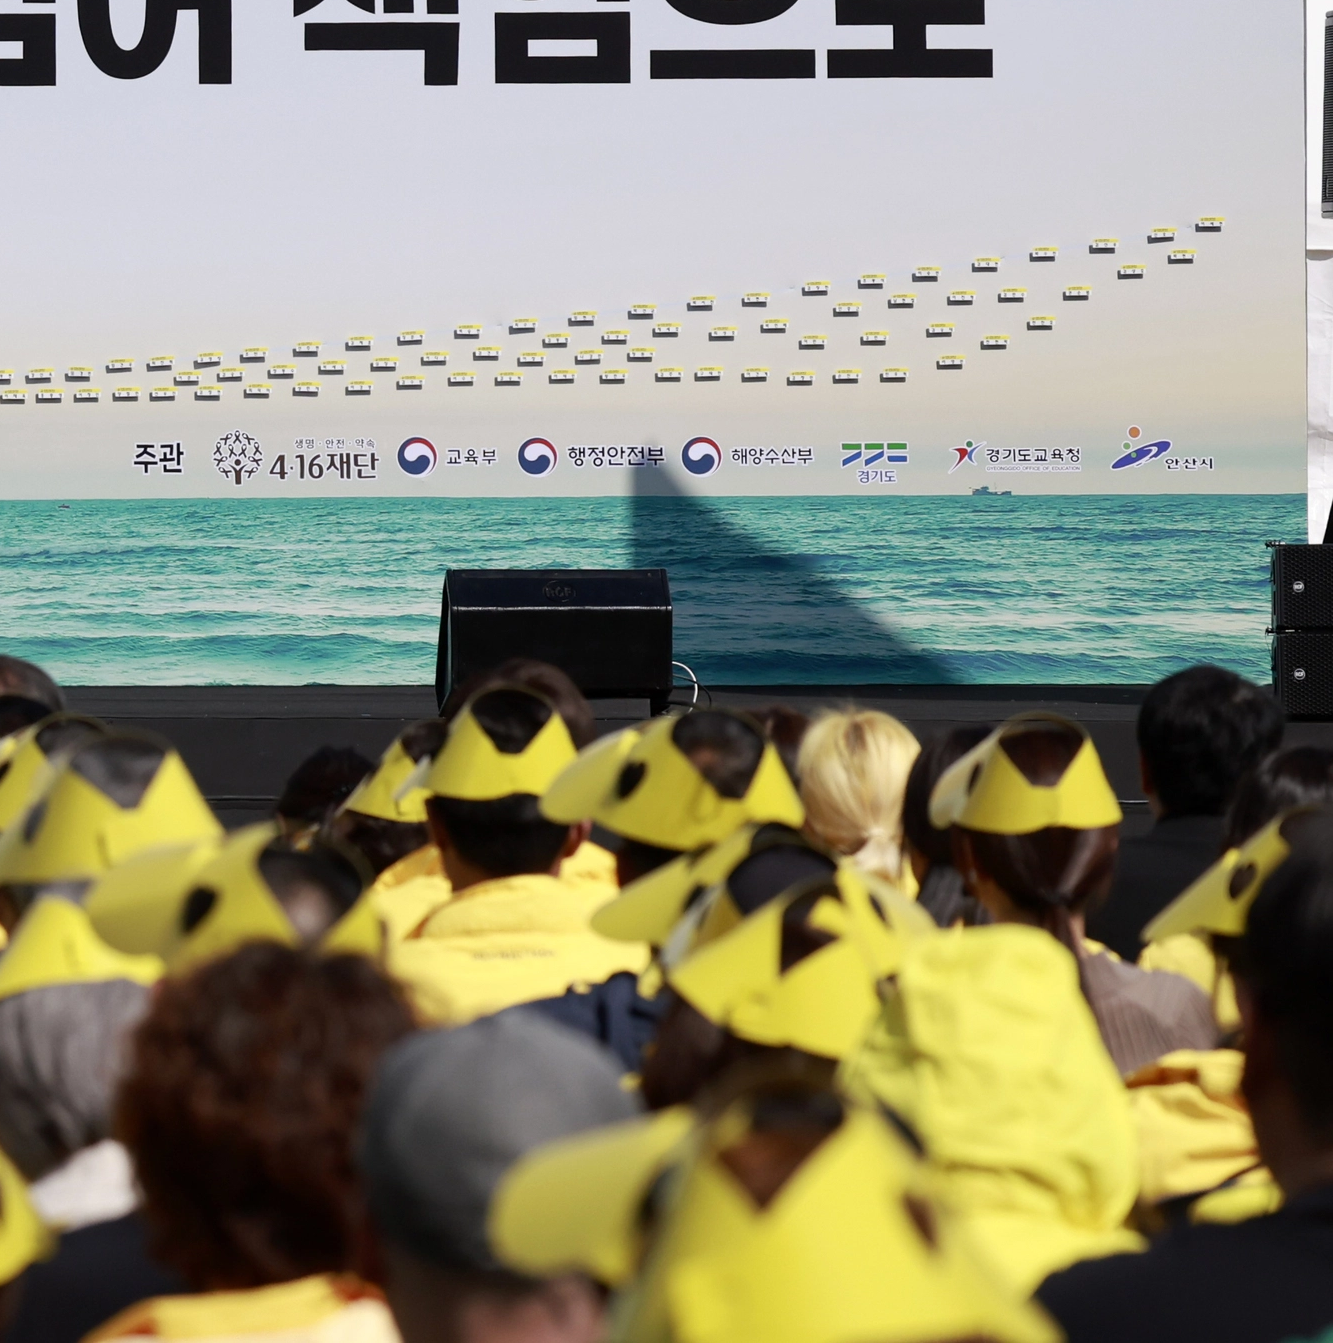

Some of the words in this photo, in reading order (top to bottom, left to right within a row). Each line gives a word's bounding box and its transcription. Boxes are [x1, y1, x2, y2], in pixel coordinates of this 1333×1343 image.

[134, 443, 184, 474] 주관
[446, 448, 497, 465] 교육부
[567, 446, 665, 467] 행정안전부
[731, 448, 813, 465] 해양수산부
[986, 448, 1080, 463] 경기도교육청
[1165, 458, 1213, 470] 안산시
[857, 470, 896, 484] 경기도
